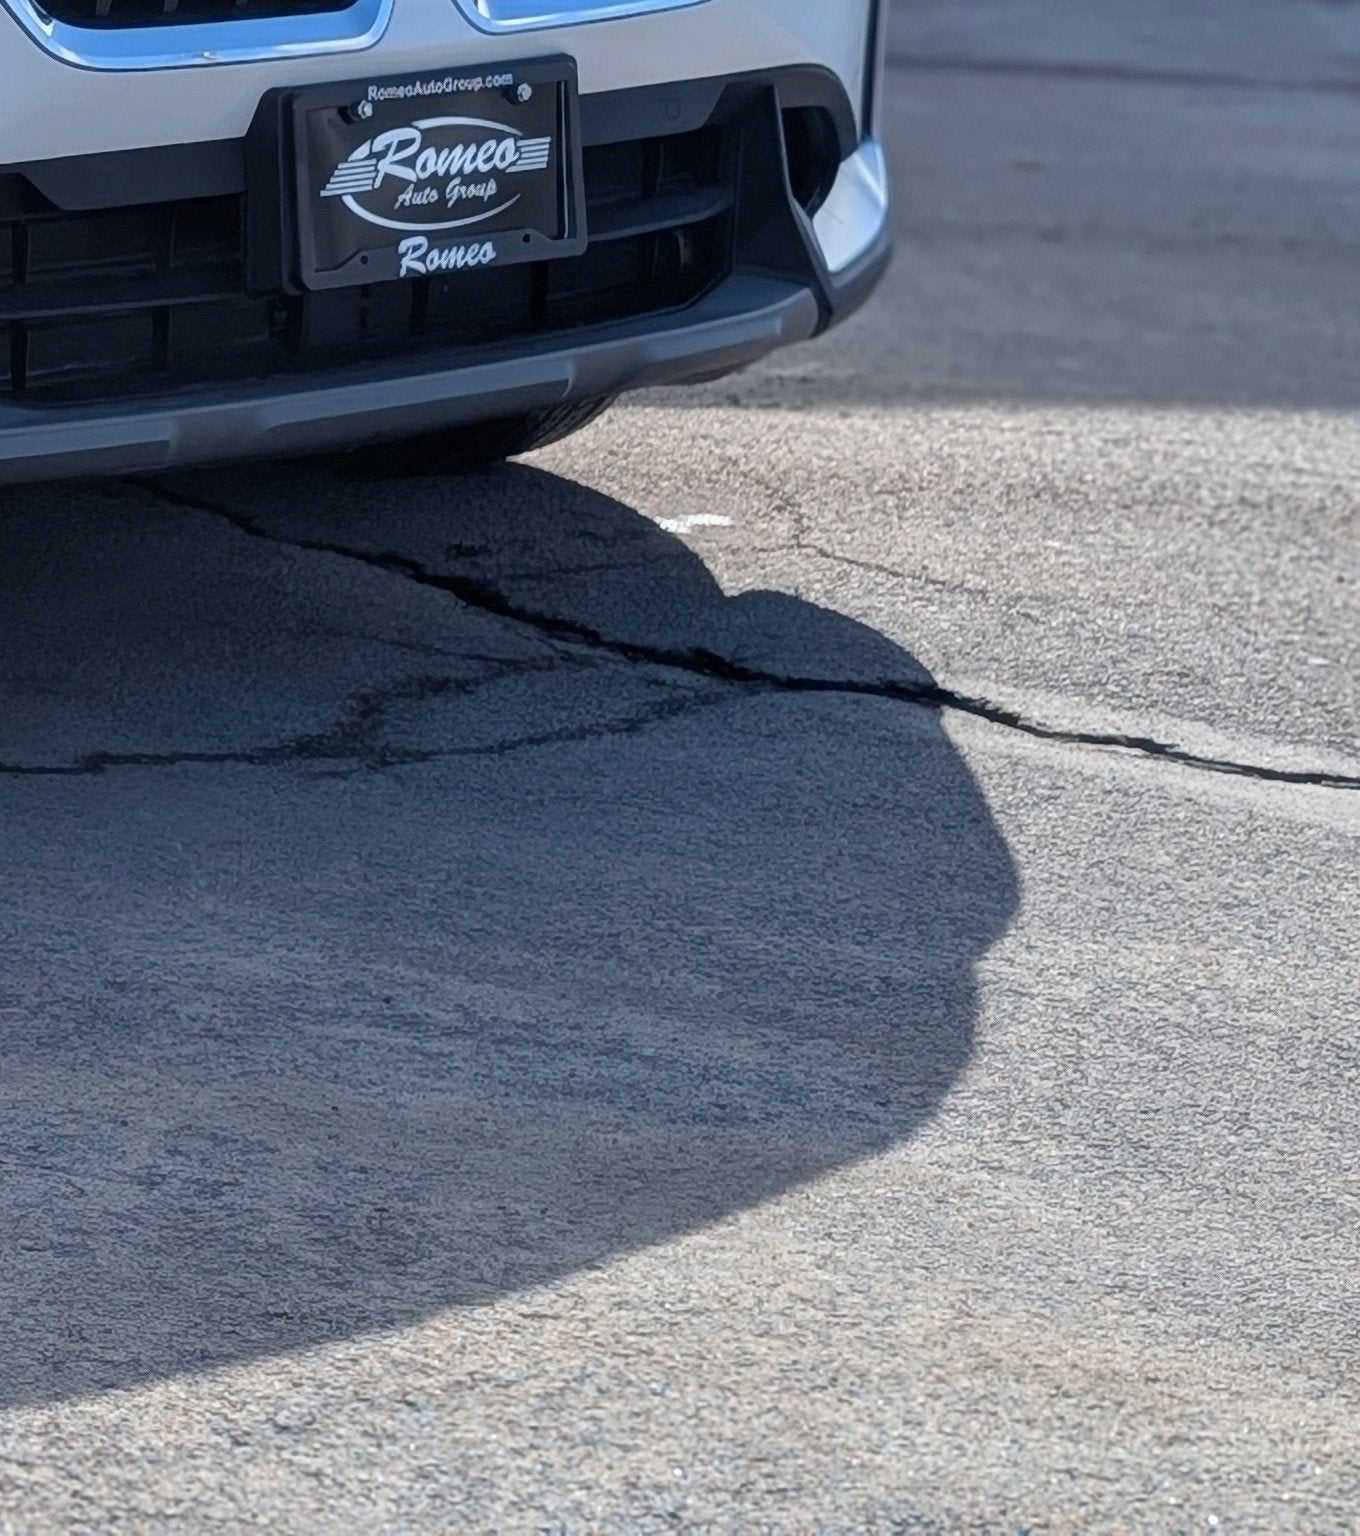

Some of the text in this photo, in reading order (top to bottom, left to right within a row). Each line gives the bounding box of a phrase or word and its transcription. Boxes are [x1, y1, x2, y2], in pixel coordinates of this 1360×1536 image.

[367, 73, 513, 101] RomeoAutoGroup.com
[372, 127, 520, 189] Romeo
[394, 176, 498, 210] Auto Group
[398, 235, 497, 278] Romeo
